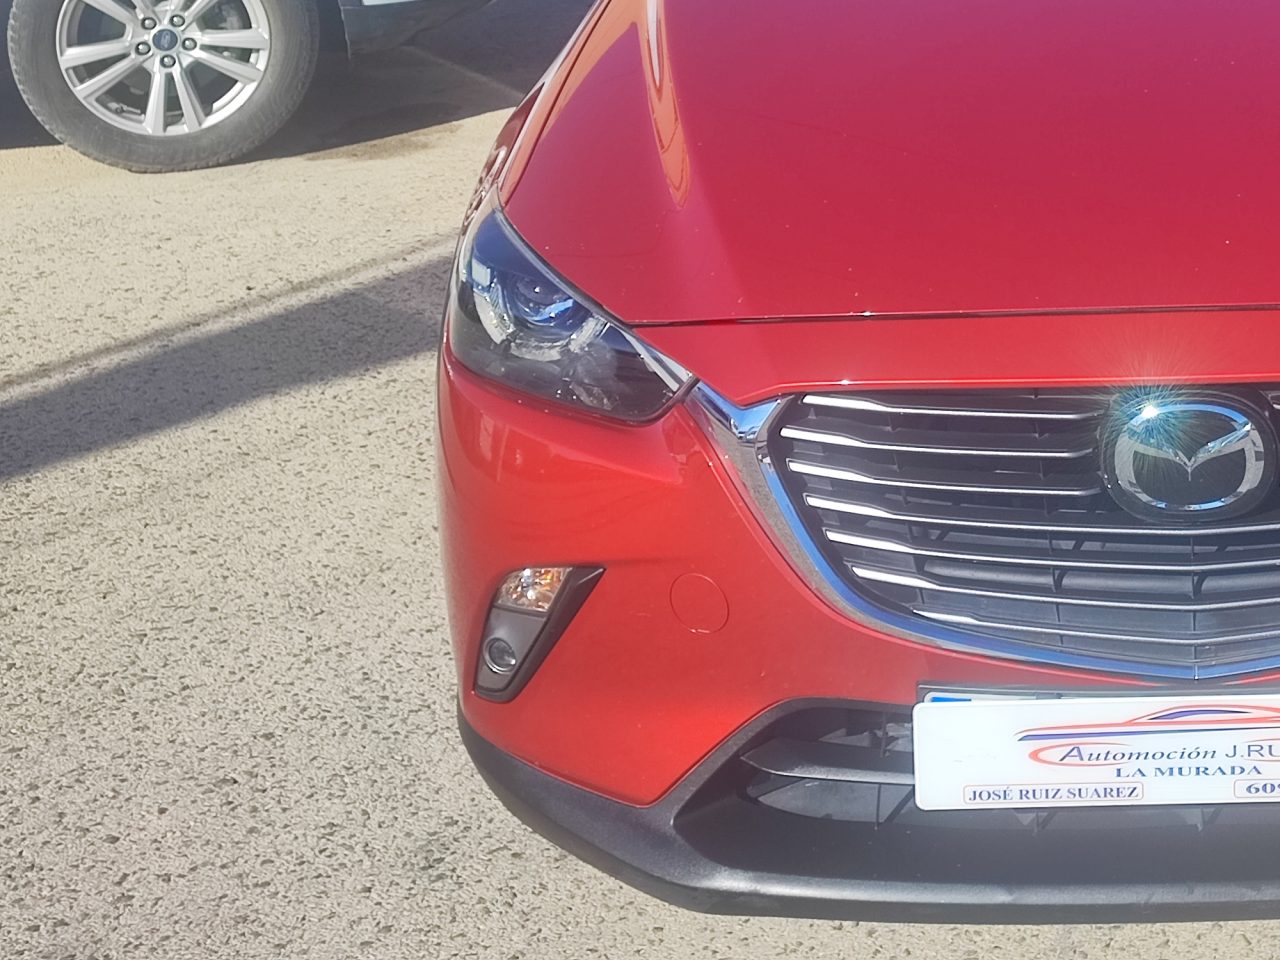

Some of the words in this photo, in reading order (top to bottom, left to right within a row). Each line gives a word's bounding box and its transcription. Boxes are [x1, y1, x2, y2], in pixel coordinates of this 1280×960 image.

[1058, 745, 1218, 763] Automoción
[1115, 766, 1147, 779] LA
[1153, 764, 1263, 778] MURADA
[968, 785, 1014, 802] JOSÉ
[1018, 787, 1062, 801] RUIZ
[1066, 785, 1140, 800] SUAREZ
